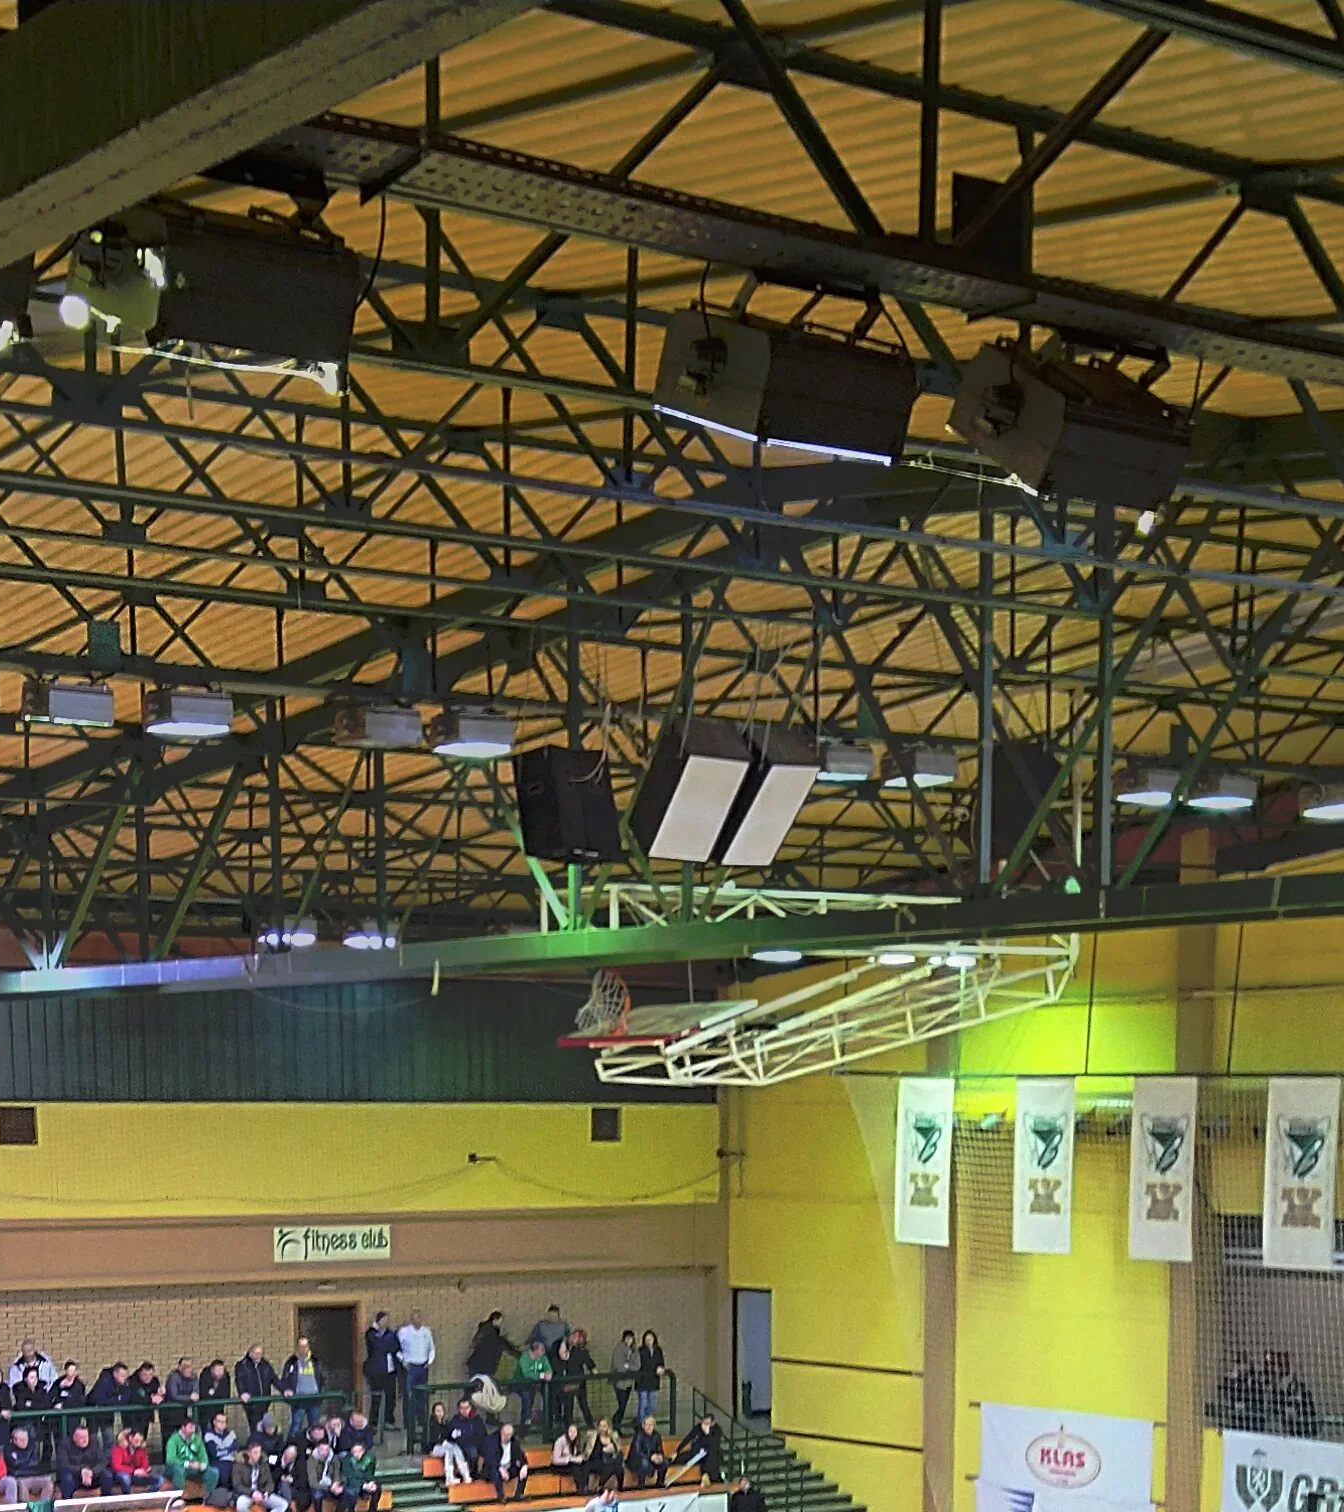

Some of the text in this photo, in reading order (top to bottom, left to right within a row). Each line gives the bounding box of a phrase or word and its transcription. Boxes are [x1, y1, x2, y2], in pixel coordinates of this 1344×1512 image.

[303, 1228, 388, 1260] fitness club
[1039, 1447, 1086, 1469] KLAS
